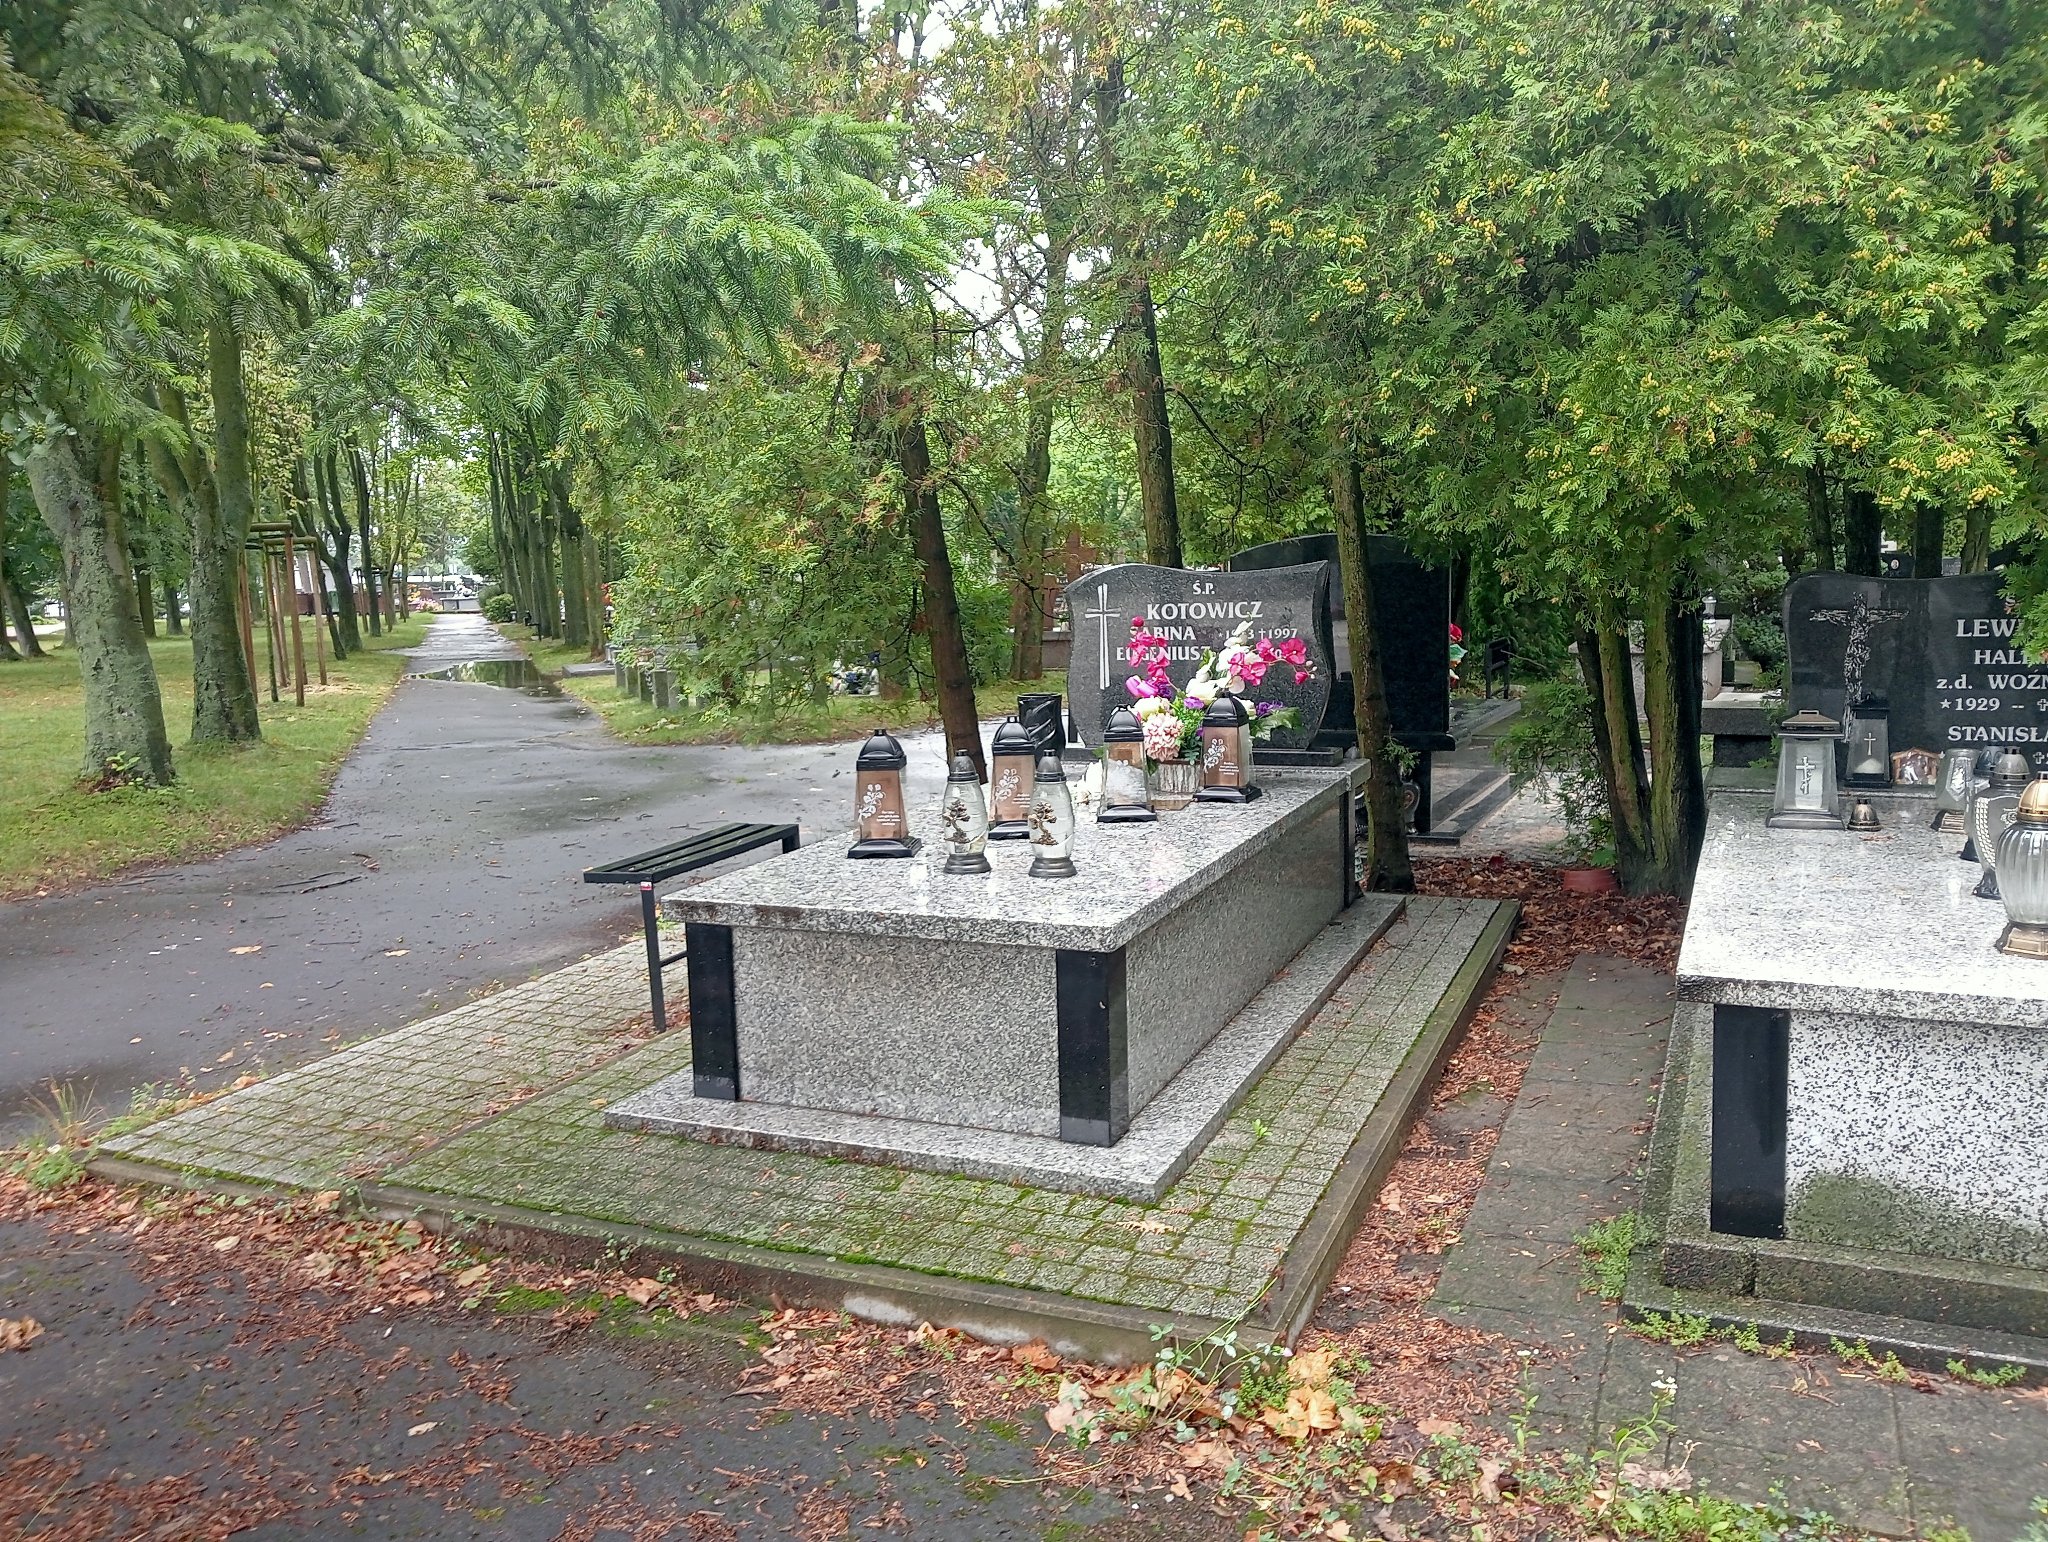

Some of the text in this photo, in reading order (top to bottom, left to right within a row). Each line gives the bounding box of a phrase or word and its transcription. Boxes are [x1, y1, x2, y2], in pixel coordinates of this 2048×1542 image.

[1192, 579, 1216, 595] Ś.P.
[1147, 602, 1263, 620] KOTOWICZ
[1956, 618, 2024, 637] LEW
[1936, 673, 1973, 690] z.d.
[1955, 697, 2001, 711] 1929
